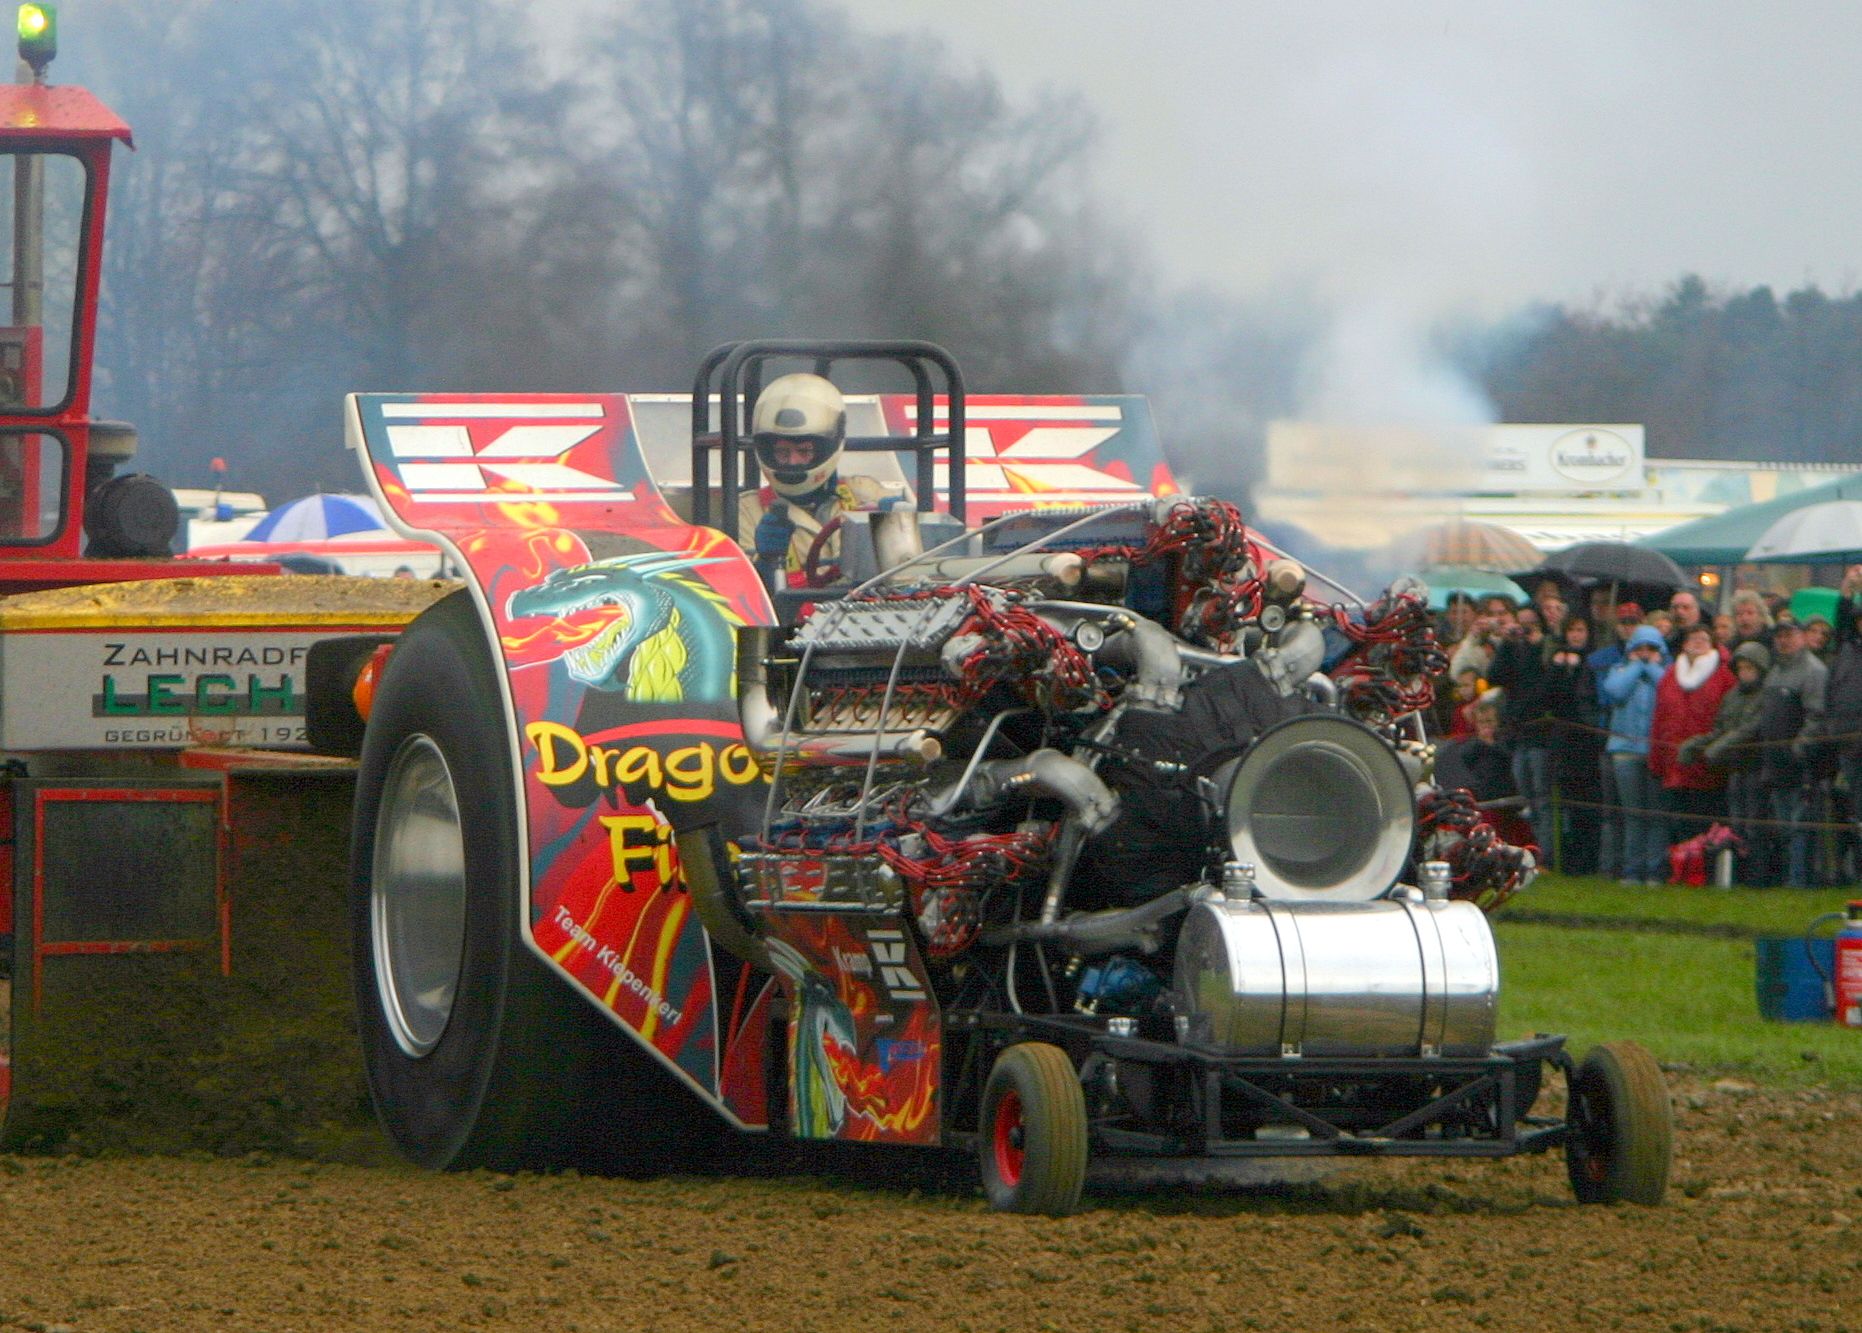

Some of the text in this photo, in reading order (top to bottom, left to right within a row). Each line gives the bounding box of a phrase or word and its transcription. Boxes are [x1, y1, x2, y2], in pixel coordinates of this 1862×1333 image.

[104, 725, 248, 743] GEGRÜNET
[525, 720, 773, 802] Drago
[599, 815, 688, 890] Fi
[553, 905, 598, 951] Team
